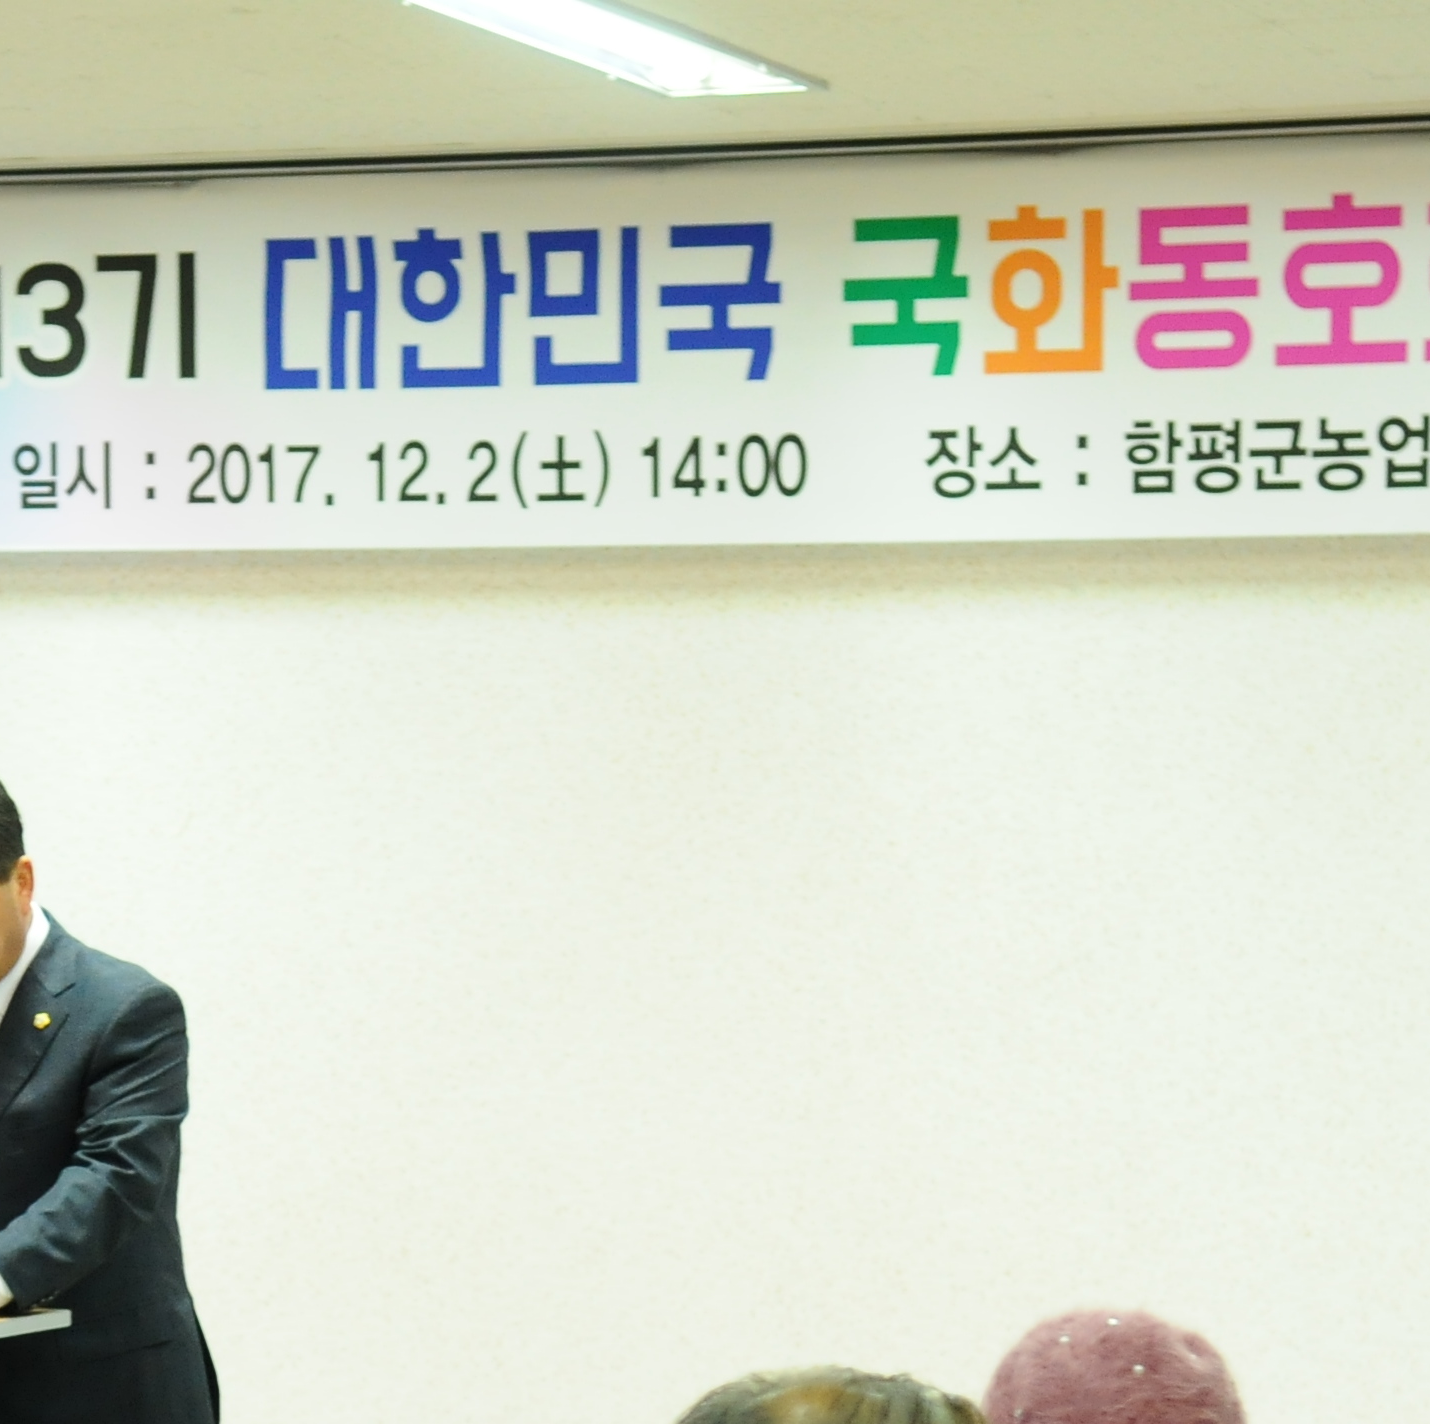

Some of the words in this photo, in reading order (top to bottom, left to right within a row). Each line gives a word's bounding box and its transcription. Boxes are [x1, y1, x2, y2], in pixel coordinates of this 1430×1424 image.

[262, 222, 783, 392] 대한민국
[12, 440, 112, 510] 일시
[145, 451, 156, 502] :
[640, 432, 809, 500] 14:00
[924, 424, 1042, 500] 장소
[1076, 433, 1089, 488] :
